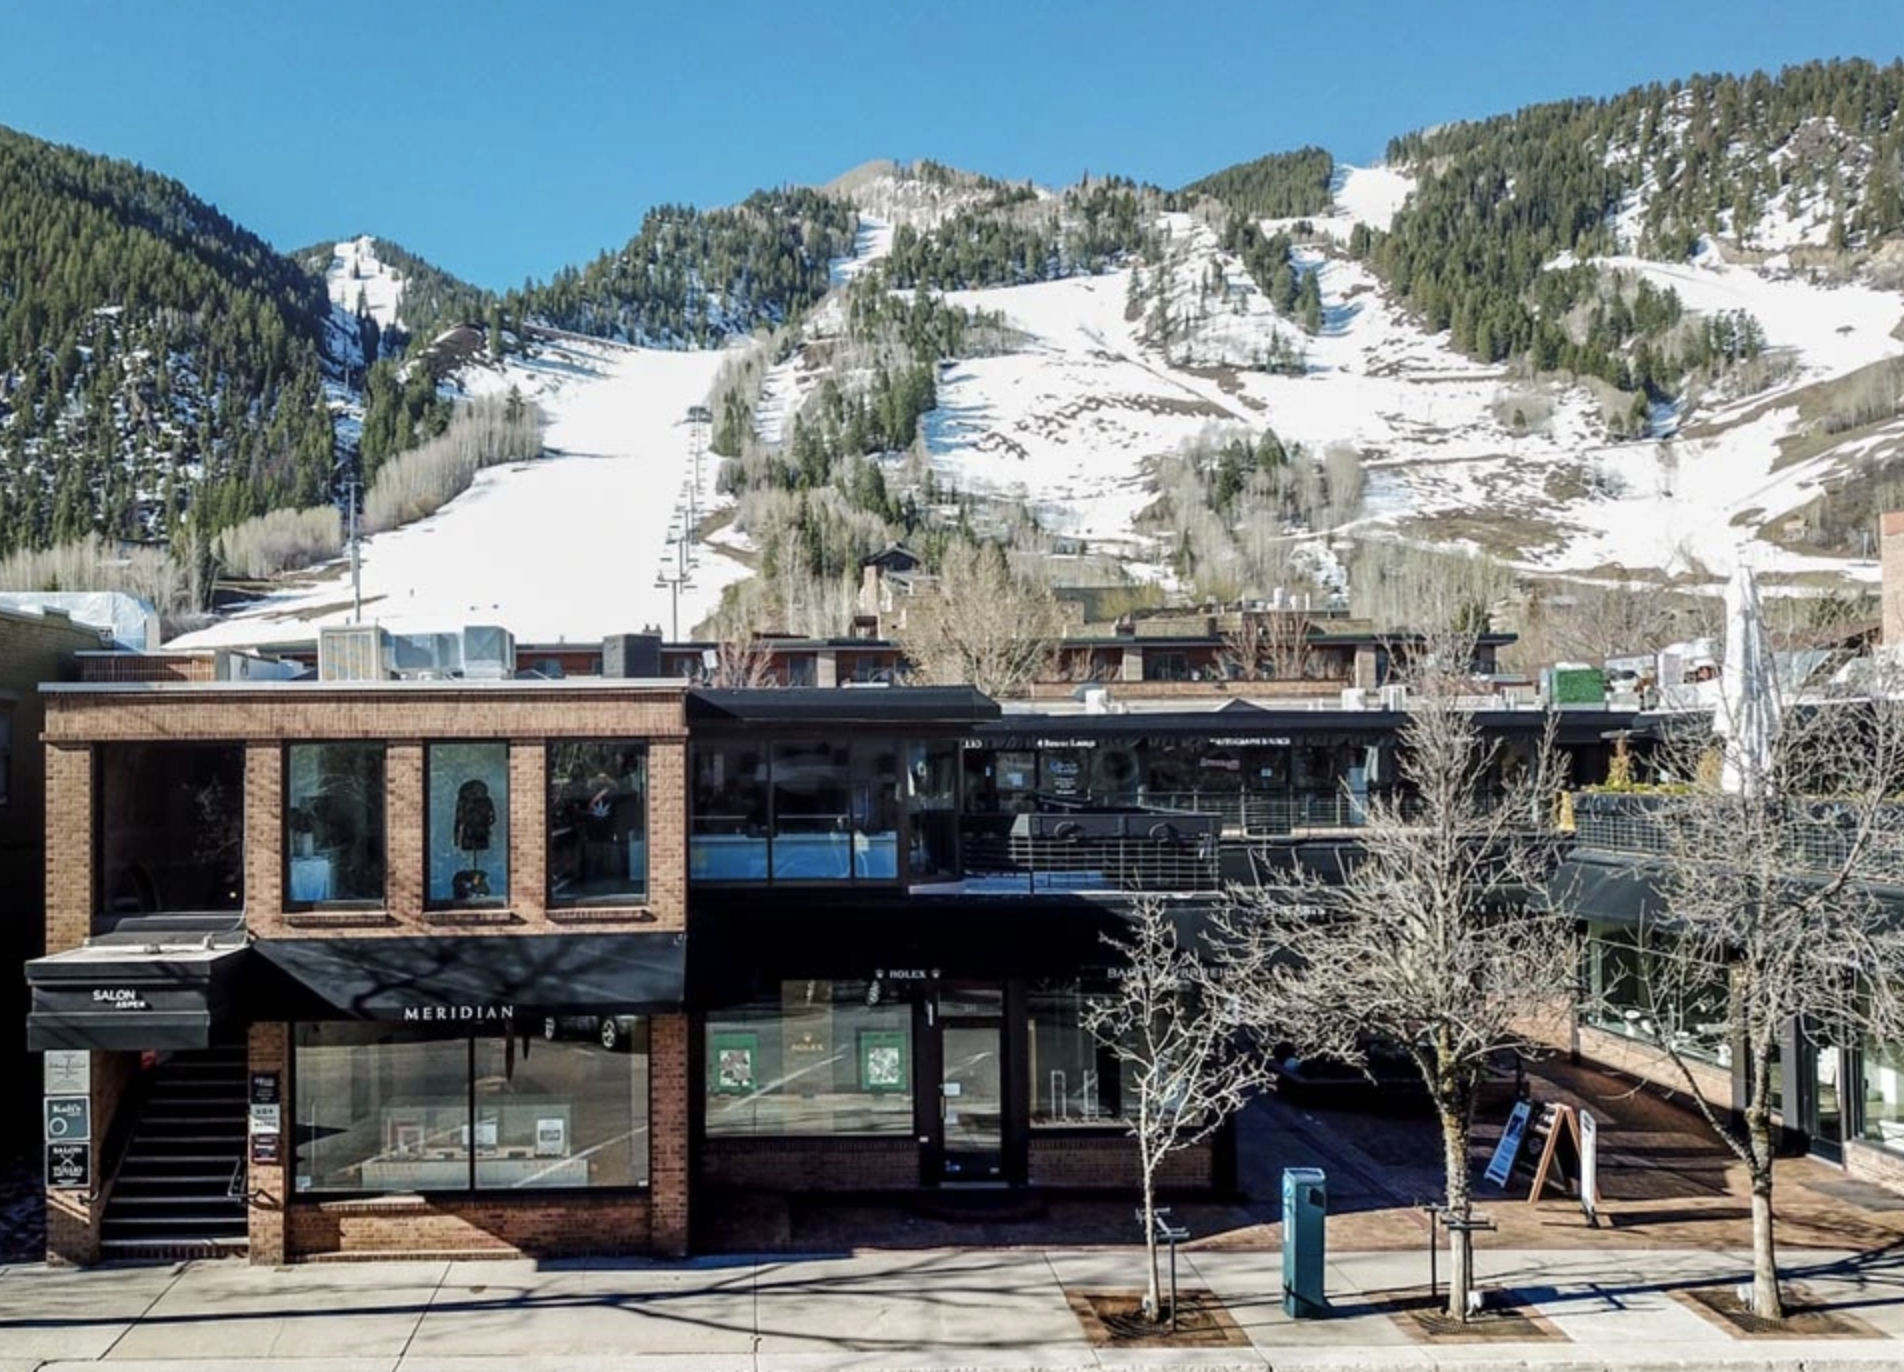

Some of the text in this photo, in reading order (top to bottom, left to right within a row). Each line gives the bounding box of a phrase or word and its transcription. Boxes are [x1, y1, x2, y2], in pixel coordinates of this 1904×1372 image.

[889, 969, 927, 979] ROLEX
[92, 989, 136, 1001] SALON
[403, 1005, 514, 1021] MERIDIAN
